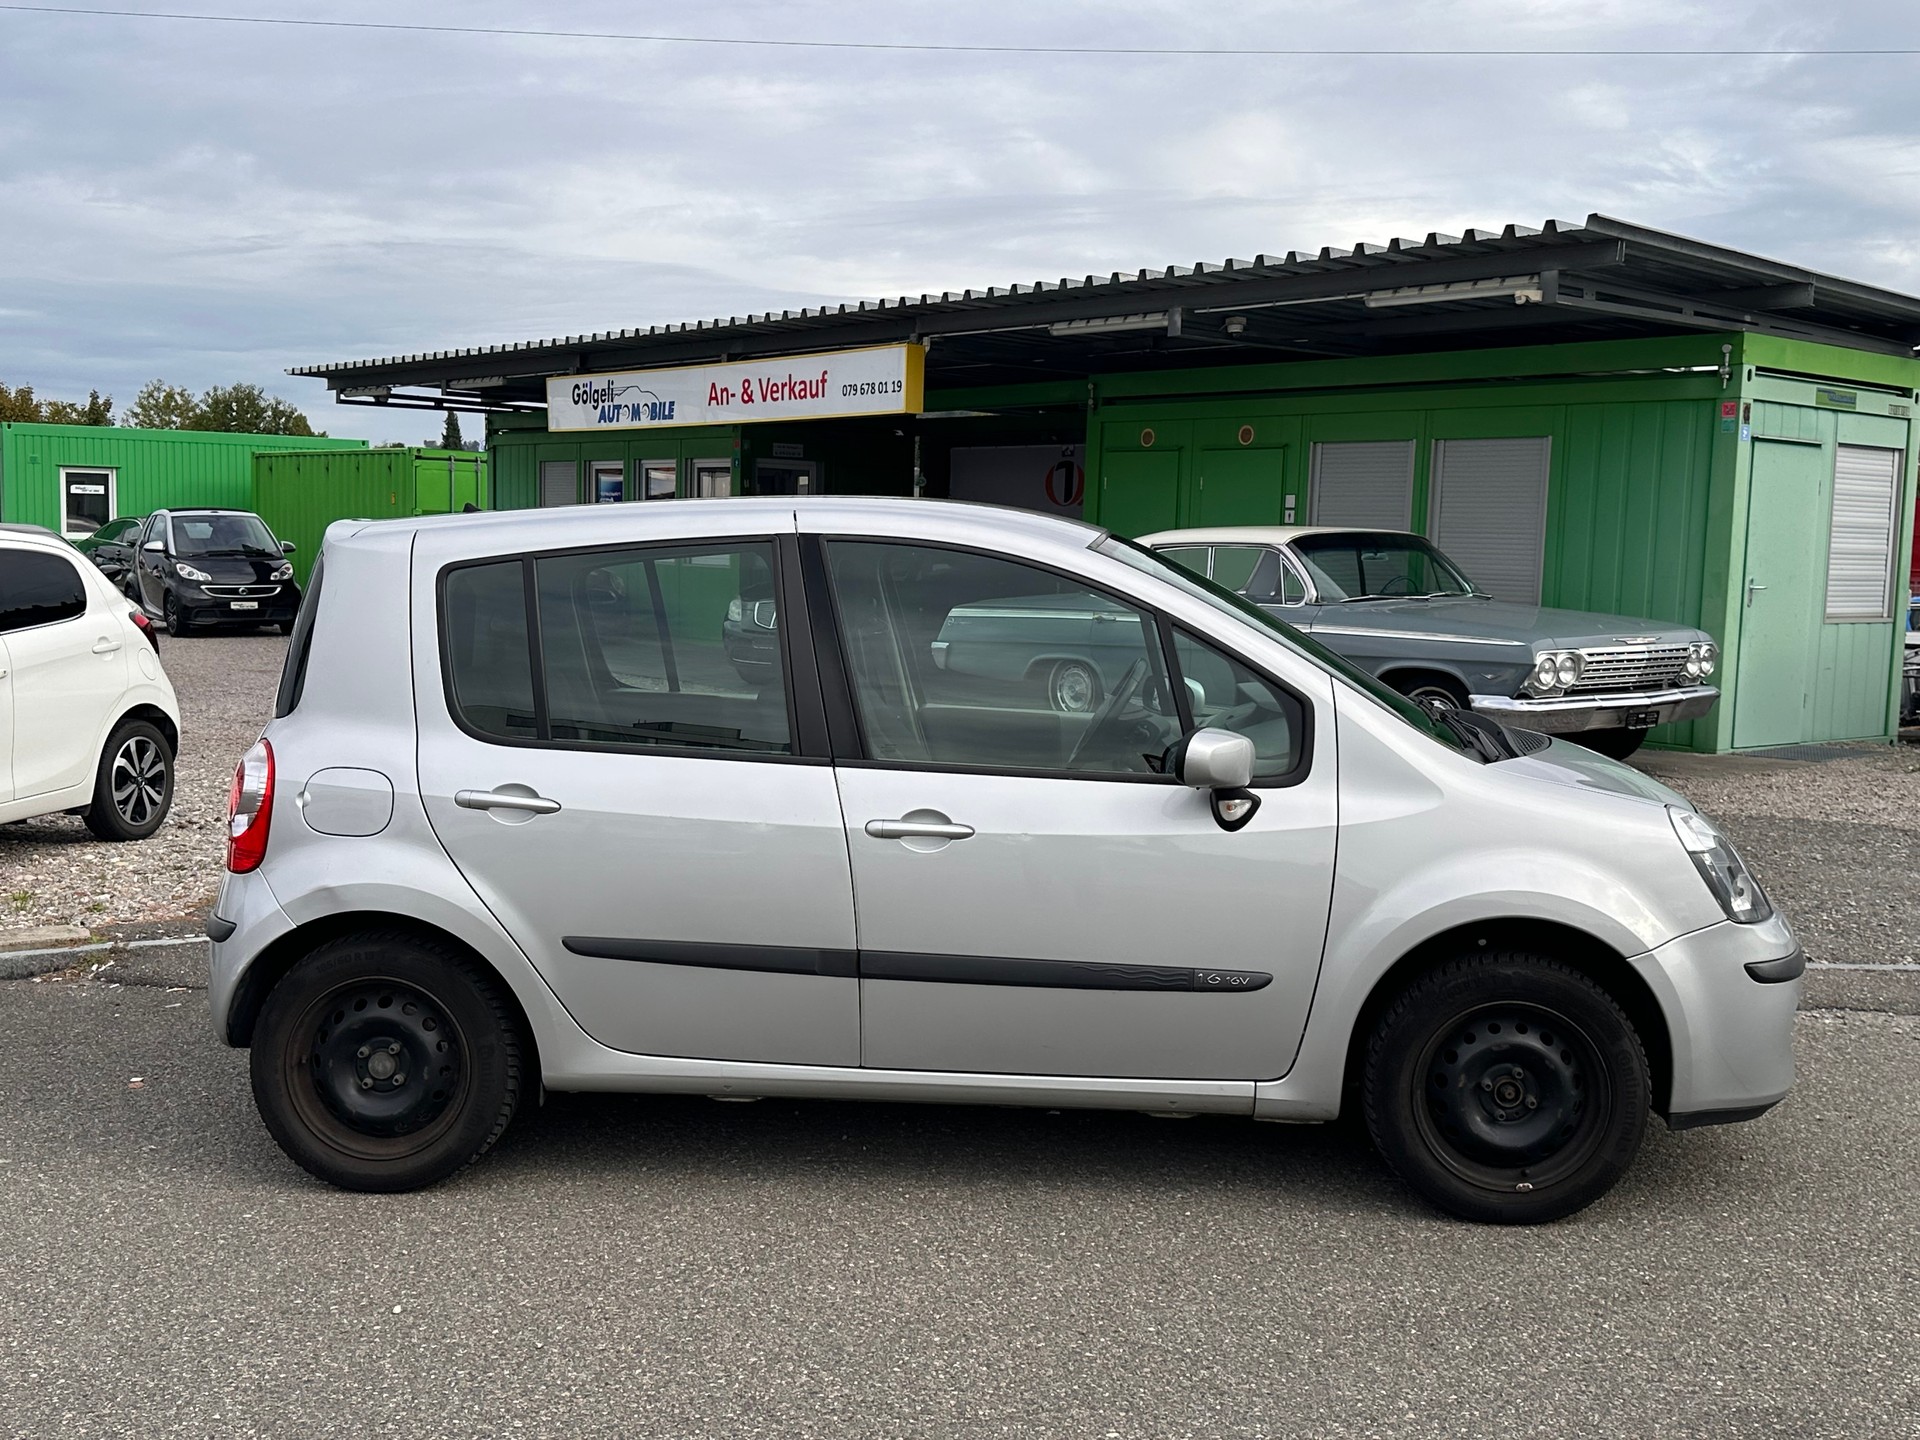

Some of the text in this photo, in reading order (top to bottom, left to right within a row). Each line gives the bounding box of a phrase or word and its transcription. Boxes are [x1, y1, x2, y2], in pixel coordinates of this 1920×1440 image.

[572, 380, 614, 410] Gölgeli
[708, 370, 902, 406] An- & Verkauf 079 678 01 19
